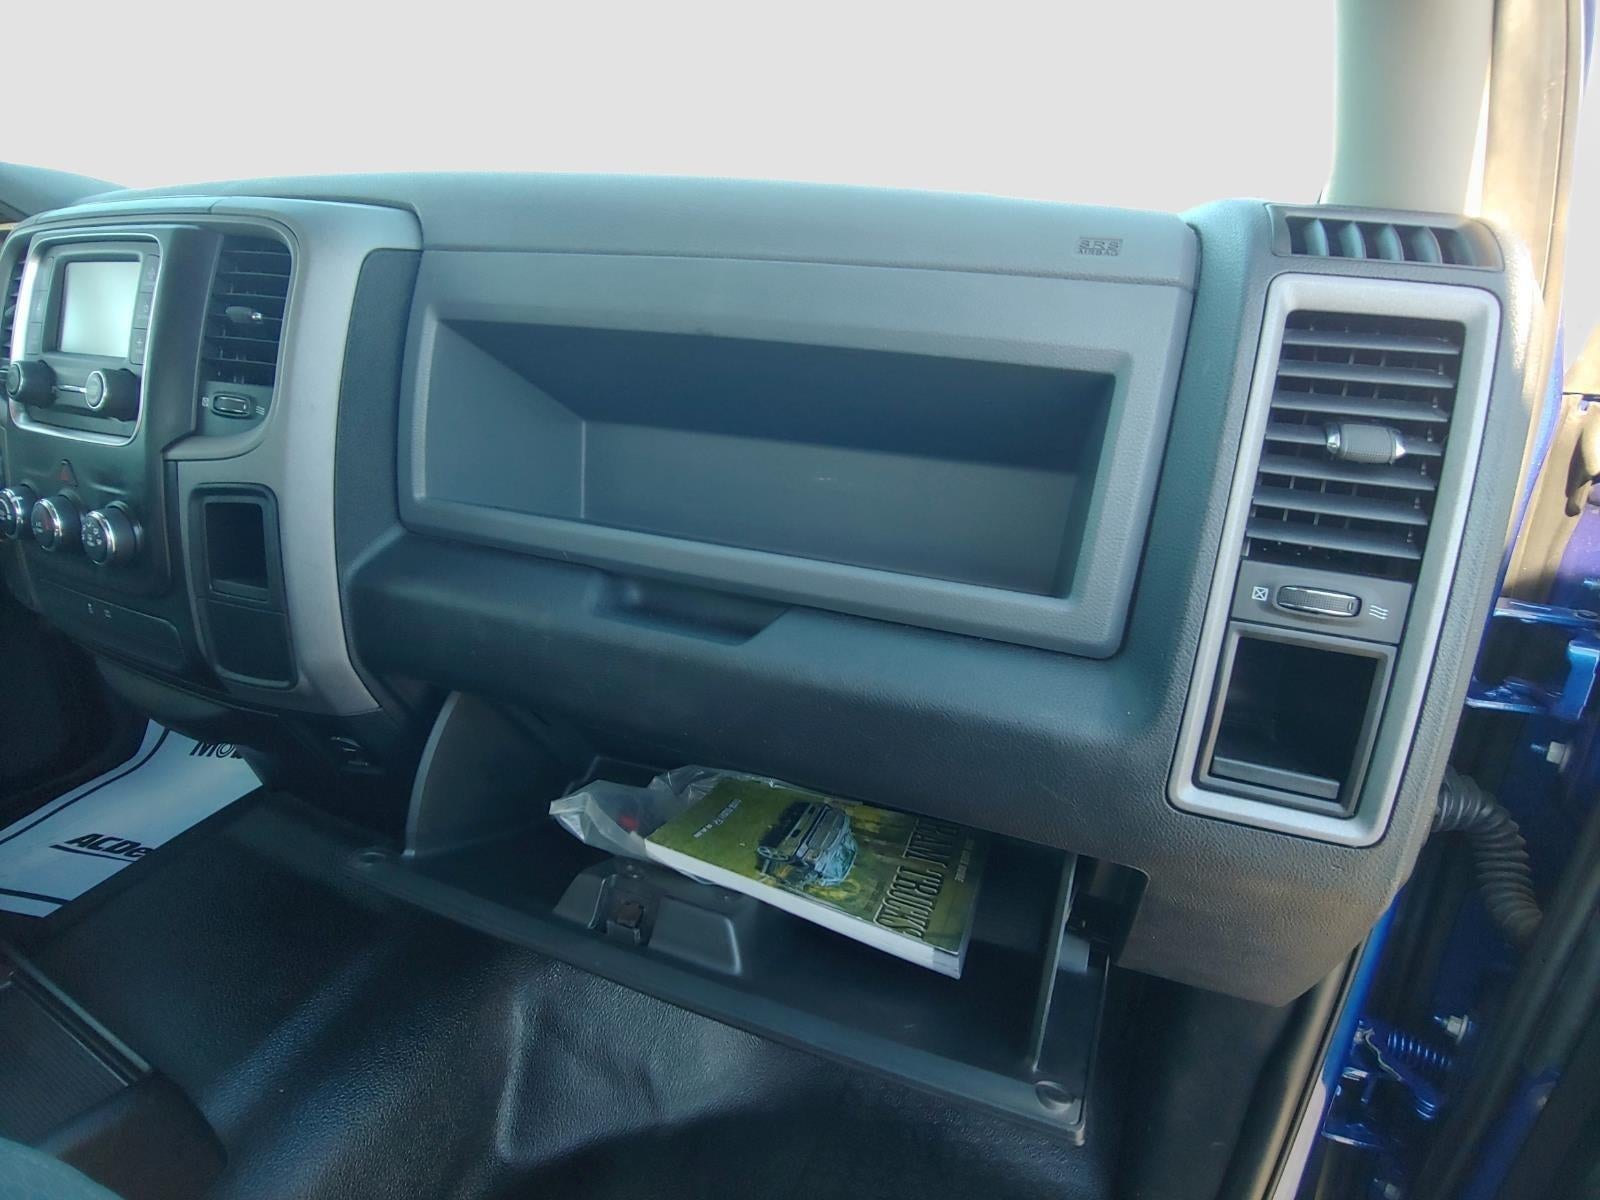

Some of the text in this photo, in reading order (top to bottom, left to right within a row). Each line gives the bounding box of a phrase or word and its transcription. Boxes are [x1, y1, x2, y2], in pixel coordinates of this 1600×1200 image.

[1079, 239, 1119, 249] SRS
[1079, 248, 1118, 256] AIRBAG
[873, 866, 942, 940] TRUCKS
